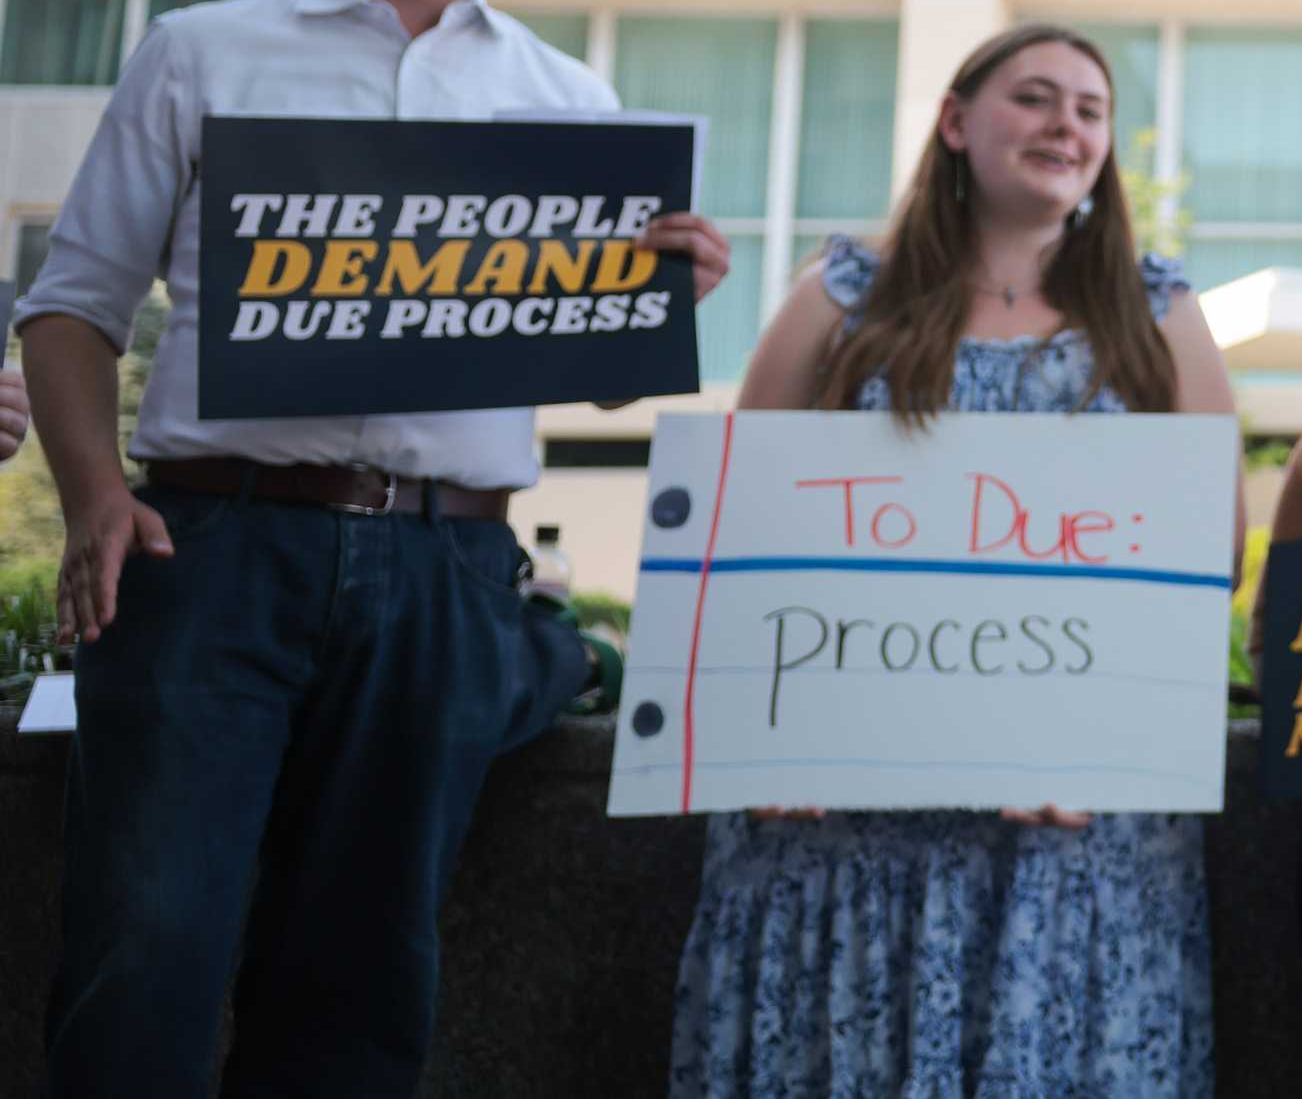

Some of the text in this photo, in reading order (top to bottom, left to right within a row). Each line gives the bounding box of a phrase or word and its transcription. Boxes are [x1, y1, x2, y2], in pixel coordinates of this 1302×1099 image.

[229, 193, 662, 239] THE PEOPLE
[237, 238, 661, 298] DEMAND
[229, 291, 672, 342] DUE PROCESS
[795, 472, 1144, 565] To Due:
[762, 605, 1096, 728] process
